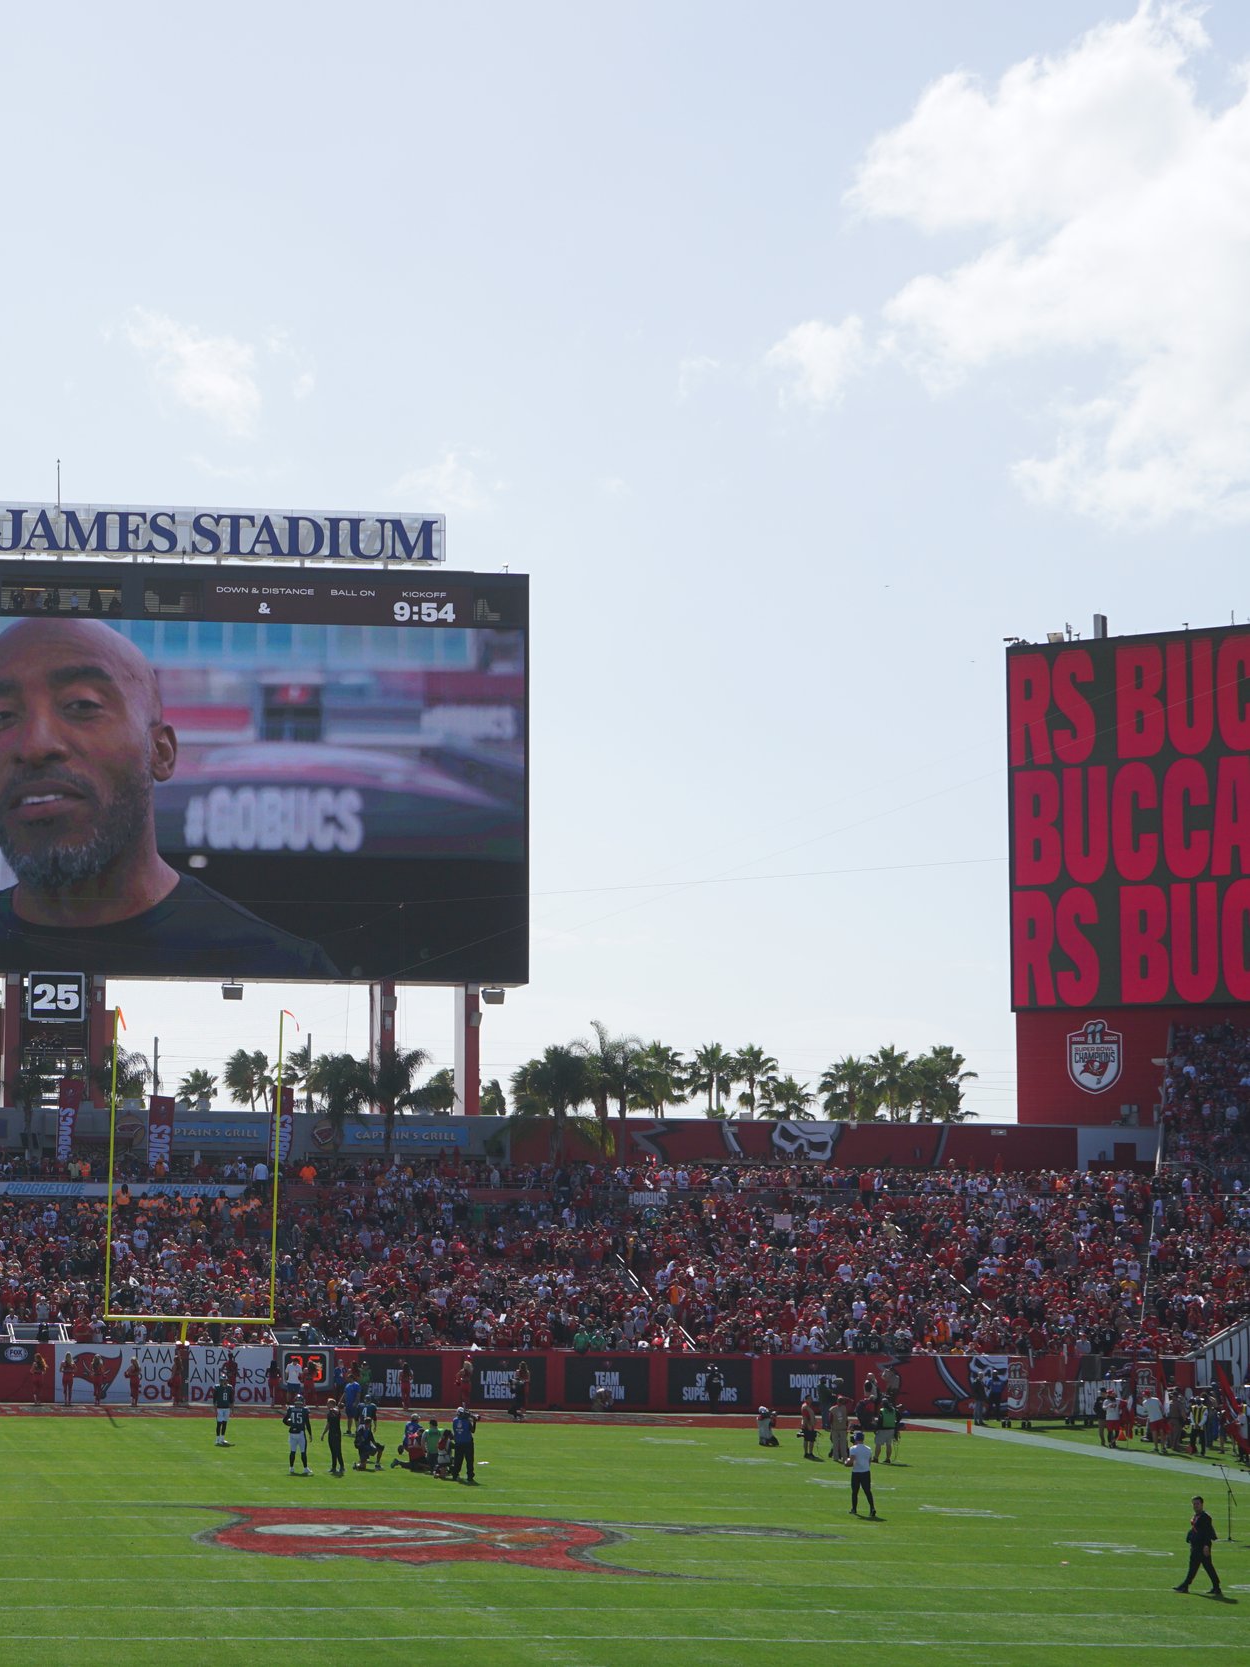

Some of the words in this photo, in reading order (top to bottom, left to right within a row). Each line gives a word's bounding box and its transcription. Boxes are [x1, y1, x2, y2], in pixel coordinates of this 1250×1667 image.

[191, 512, 438, 561] STADIUM
[216, 586, 249, 594] DOWN
[262, 587, 315, 596] DISTANCE
[330, 589, 357, 597] BALL
[402, 591, 447, 599] KICKOFF
[258, 602, 271, 614] &
[393, 602, 456, 622] 9:54
[1009, 649, 1096, 767] RS
[1013, 887, 1099, 1007] RS
[33, 983, 80, 1011] 25
[225, 1128, 260, 1138] GRILL
[423, 1131, 457, 1141] GRILL
[5, 1183, 86, 1195] PROGRESSIVE
[131, 1348, 198, 1364] TAMA
[594, 1371, 620, 1386] TEAM
[410, 1384, 433, 1398] CLUB
